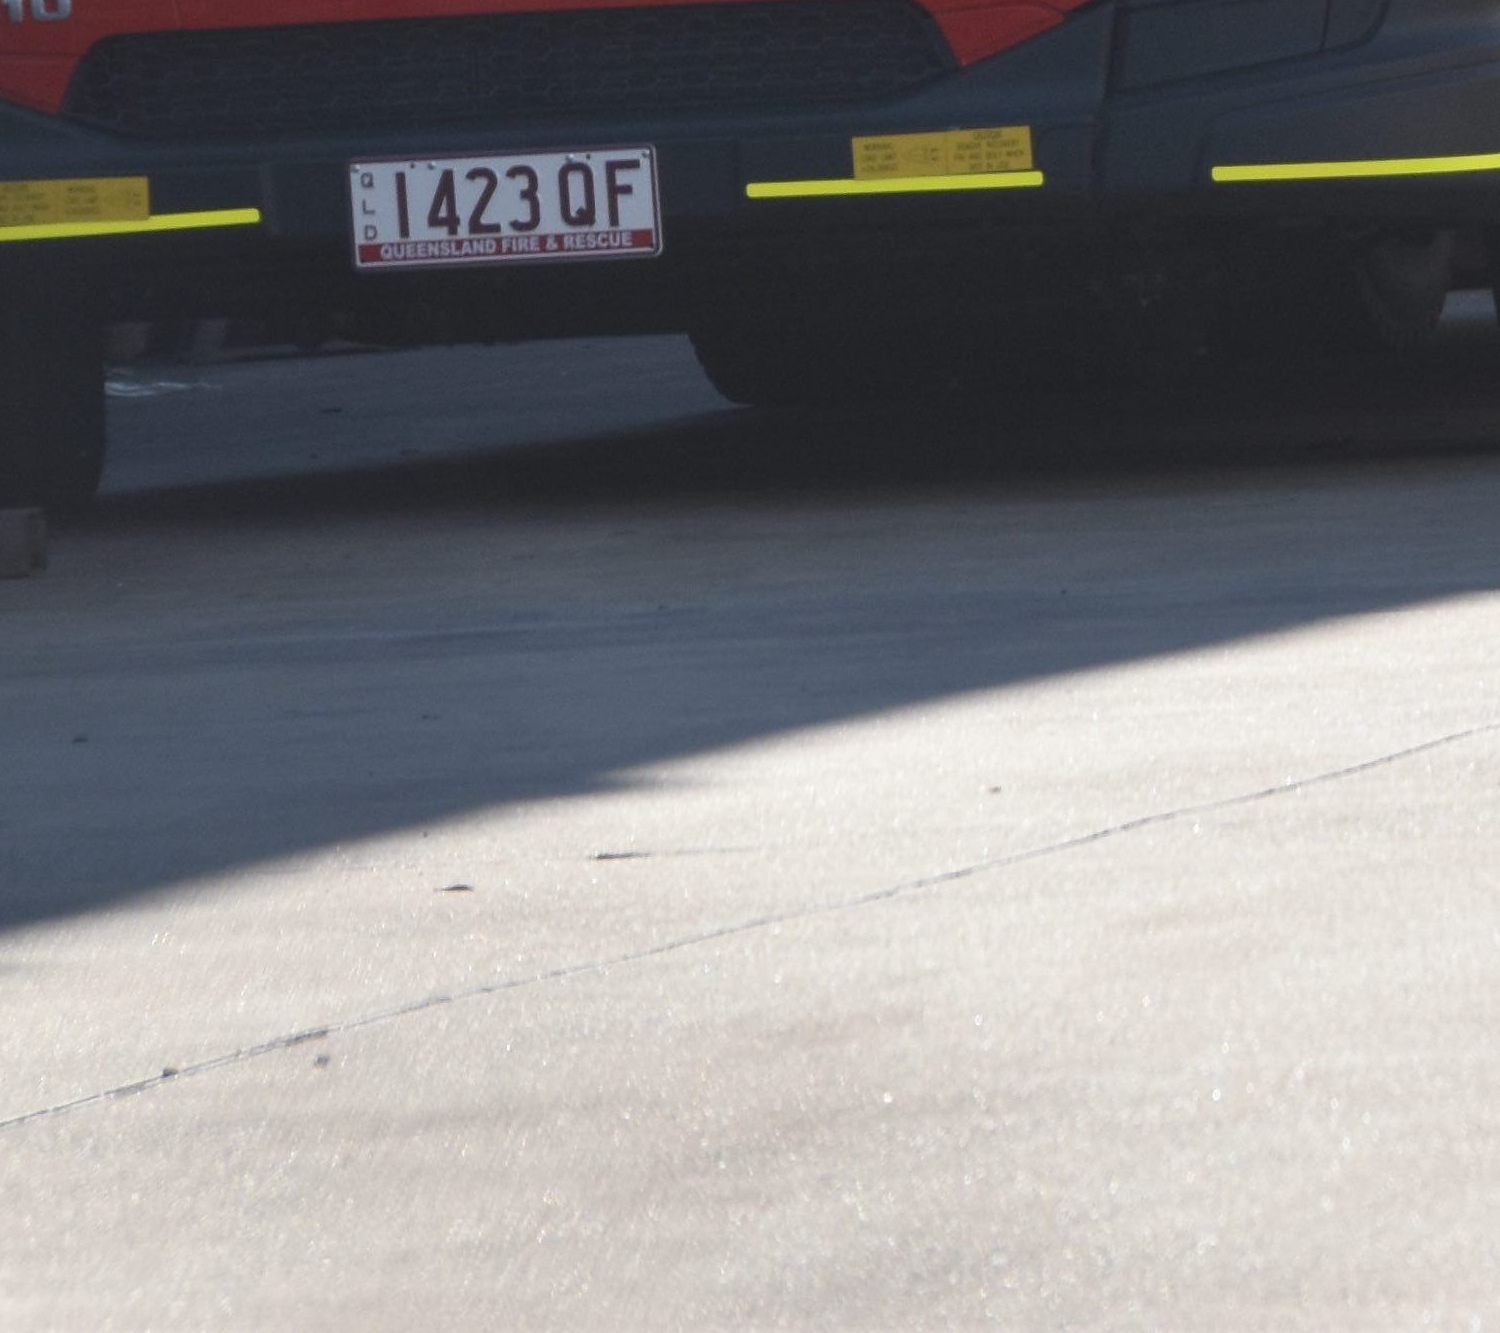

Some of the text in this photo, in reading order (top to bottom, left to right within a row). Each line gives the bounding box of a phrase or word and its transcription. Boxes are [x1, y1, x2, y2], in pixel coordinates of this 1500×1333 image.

[379, 228, 634, 260] QUEENSLAND FIRE & RESCUE
